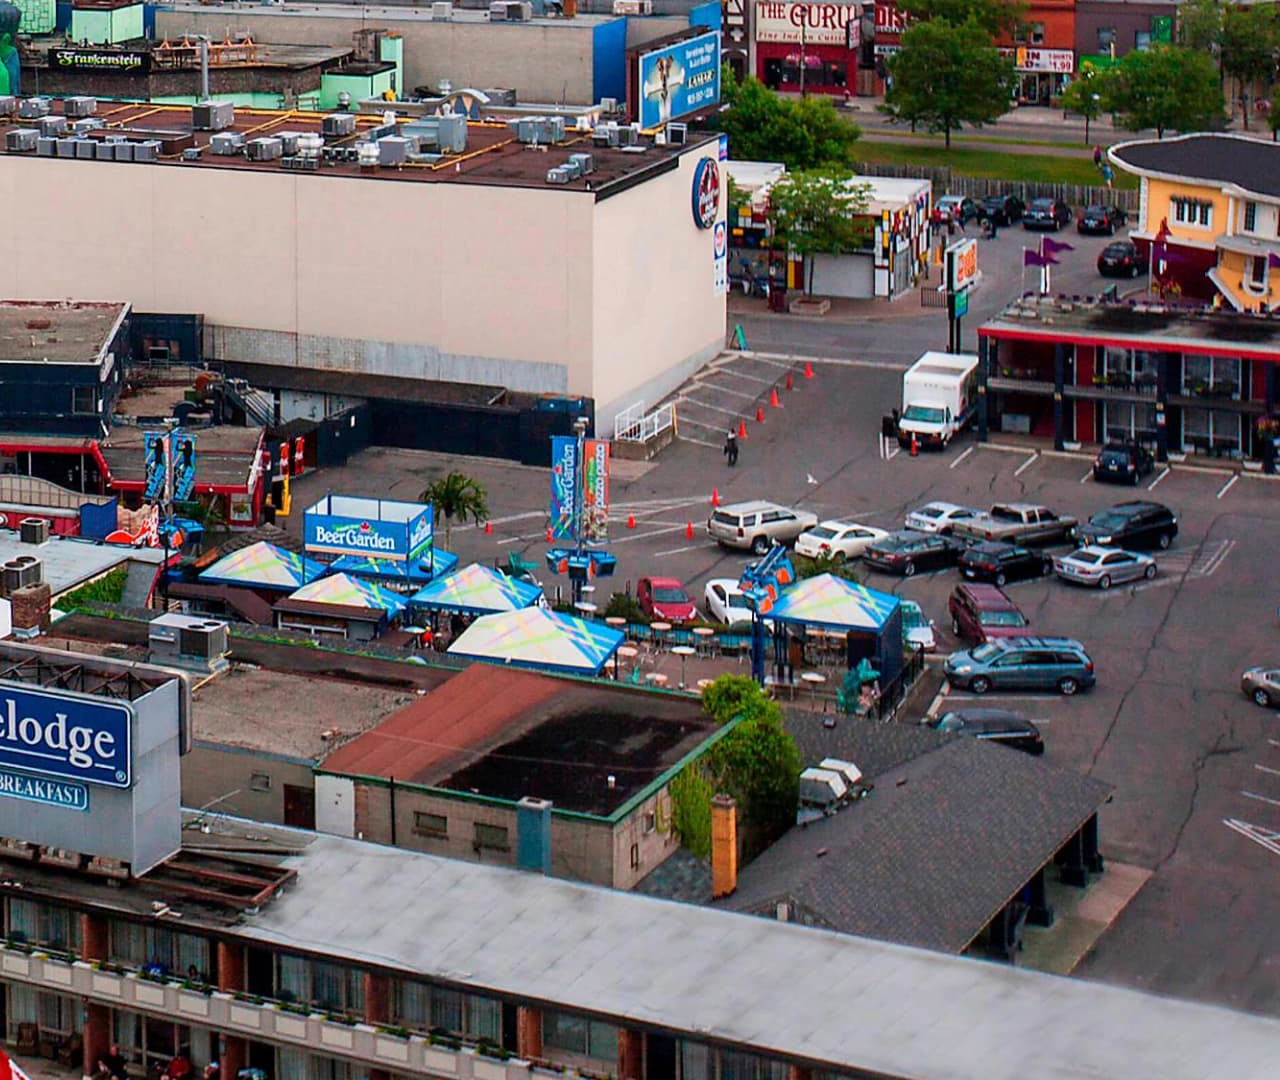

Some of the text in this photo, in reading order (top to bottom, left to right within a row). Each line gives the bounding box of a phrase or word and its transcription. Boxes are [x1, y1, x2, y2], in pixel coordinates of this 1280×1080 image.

[759, 2, 855, 30] THE GURU
[759, 31, 778, 39] Fine
[783, 32, 814, 41] Indan
[56, 51, 142, 70] Frankenstein
